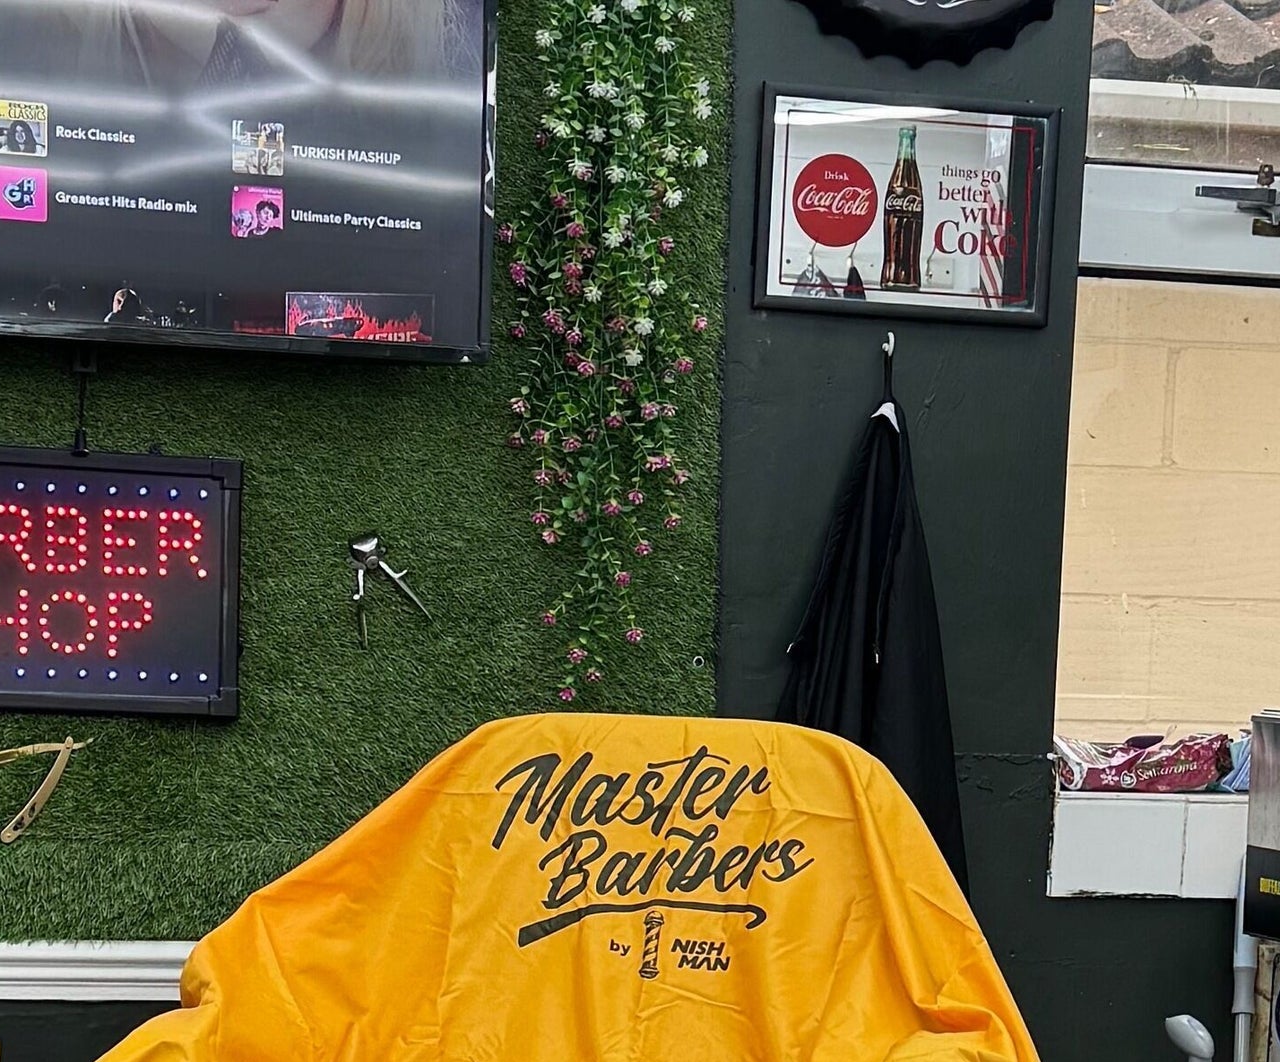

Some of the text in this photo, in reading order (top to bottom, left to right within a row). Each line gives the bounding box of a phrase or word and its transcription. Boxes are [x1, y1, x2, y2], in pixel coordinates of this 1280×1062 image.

[55, 125, 136, 144] Rock Classics
[291, 145, 401, 165] TURKISH MASHUP
[941, 164, 1002, 185] things go
[55, 191, 198, 214] Greatest Hits Radio mix
[938, 180, 991, 203] better
[291, 208, 422, 231] Ultimate Party Classics
[961, 199, 1014, 226] with
[933, 219, 1019, 259] Coke
[491, 745, 773, 851] Master
[537, 824, 816, 910] Barbers
[609, 938, 632, 957] by
[670, 938, 726, 957] NISH
[677, 954, 731, 972] MAN
